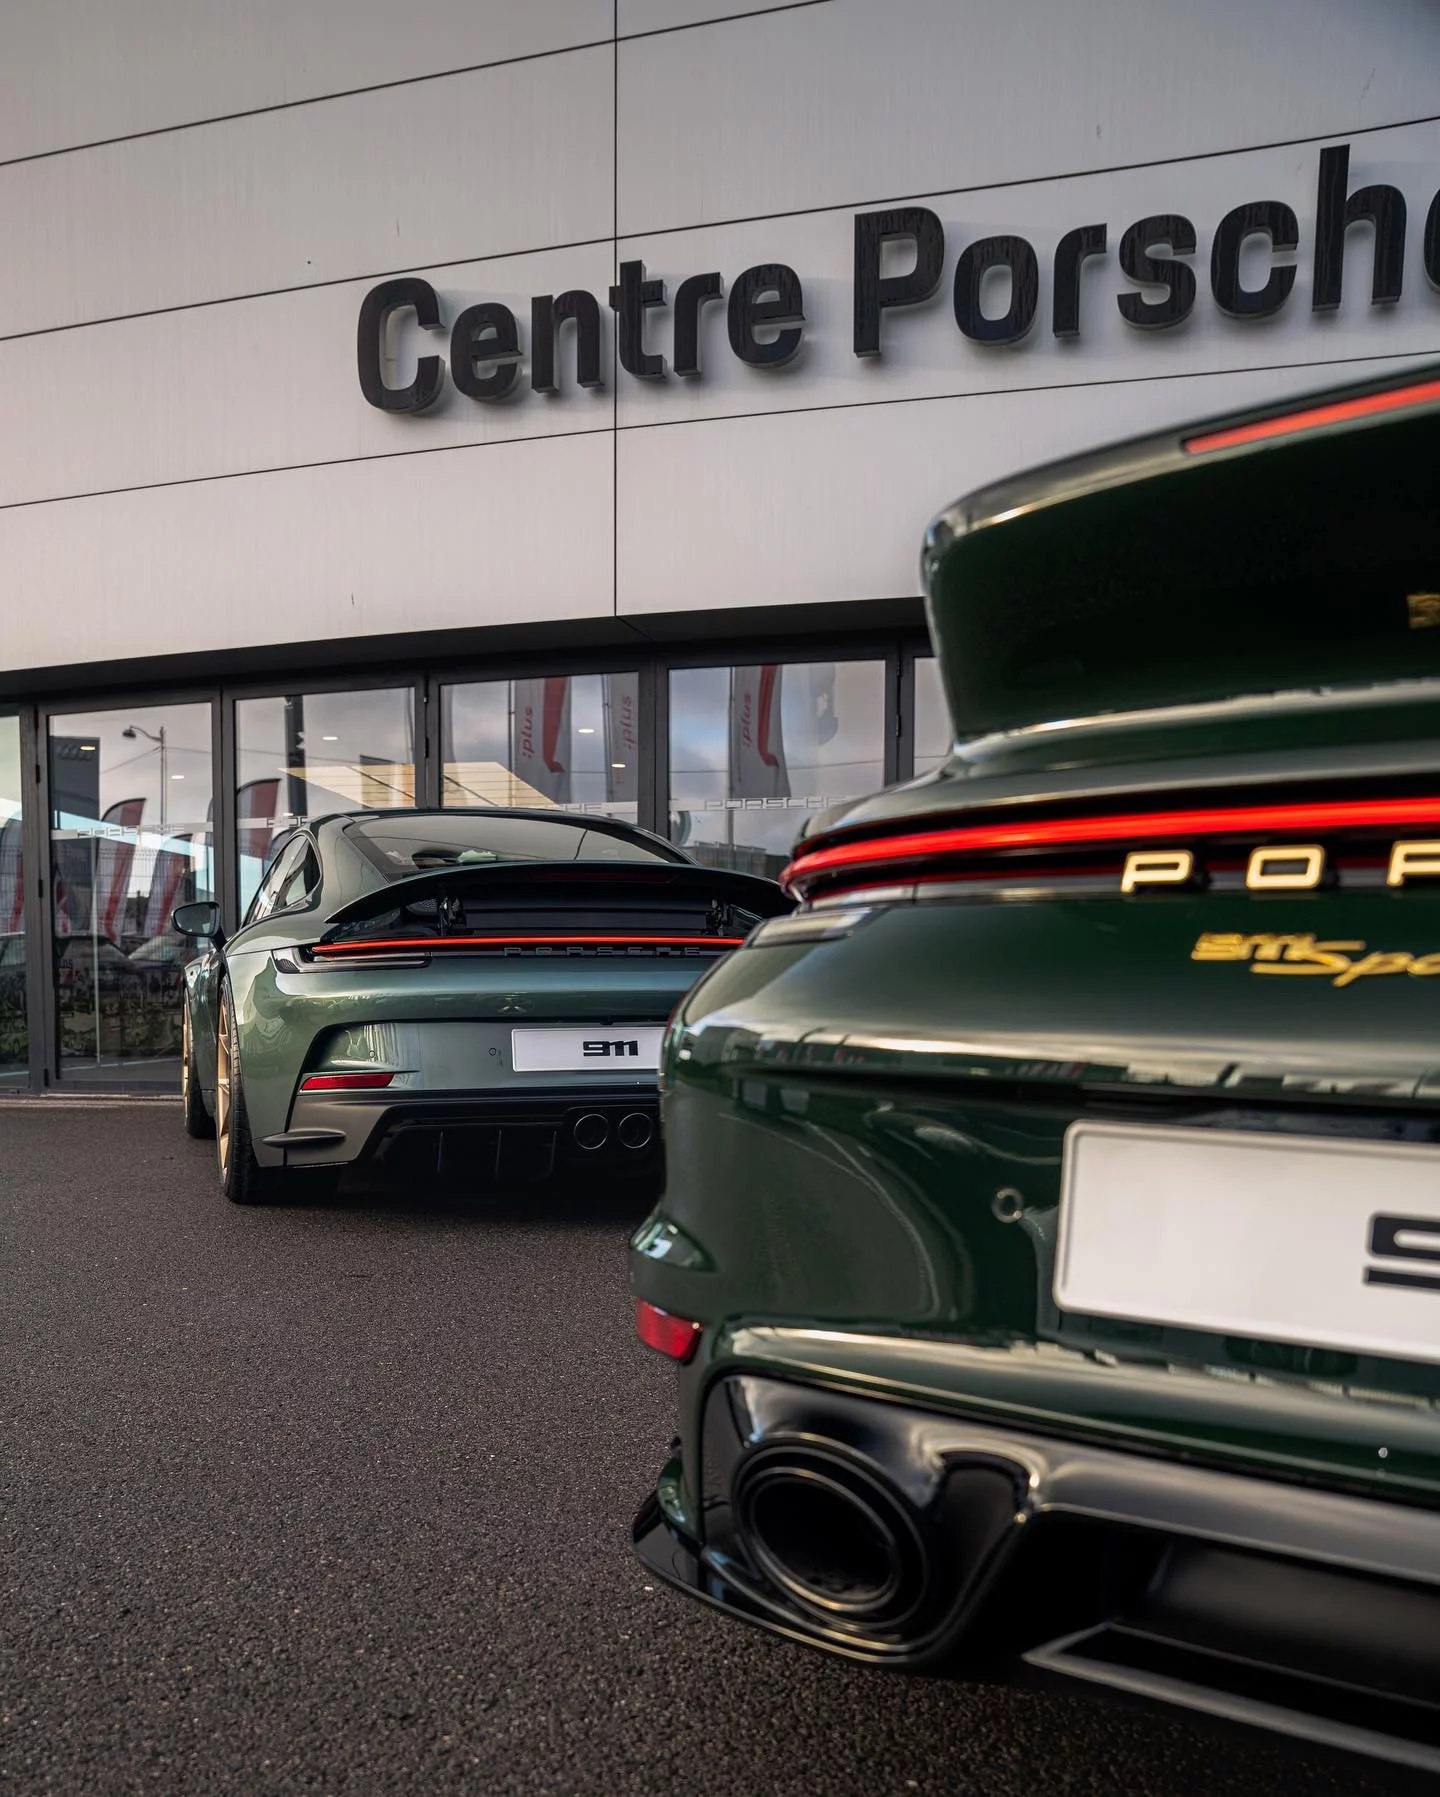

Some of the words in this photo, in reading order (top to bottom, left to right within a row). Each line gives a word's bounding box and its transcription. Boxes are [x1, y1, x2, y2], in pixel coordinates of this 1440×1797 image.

[357, 260, 806, 414] Centre
[853, 144, 1440, 358] Porsch
[583, 1040, 638, 1056] 911
